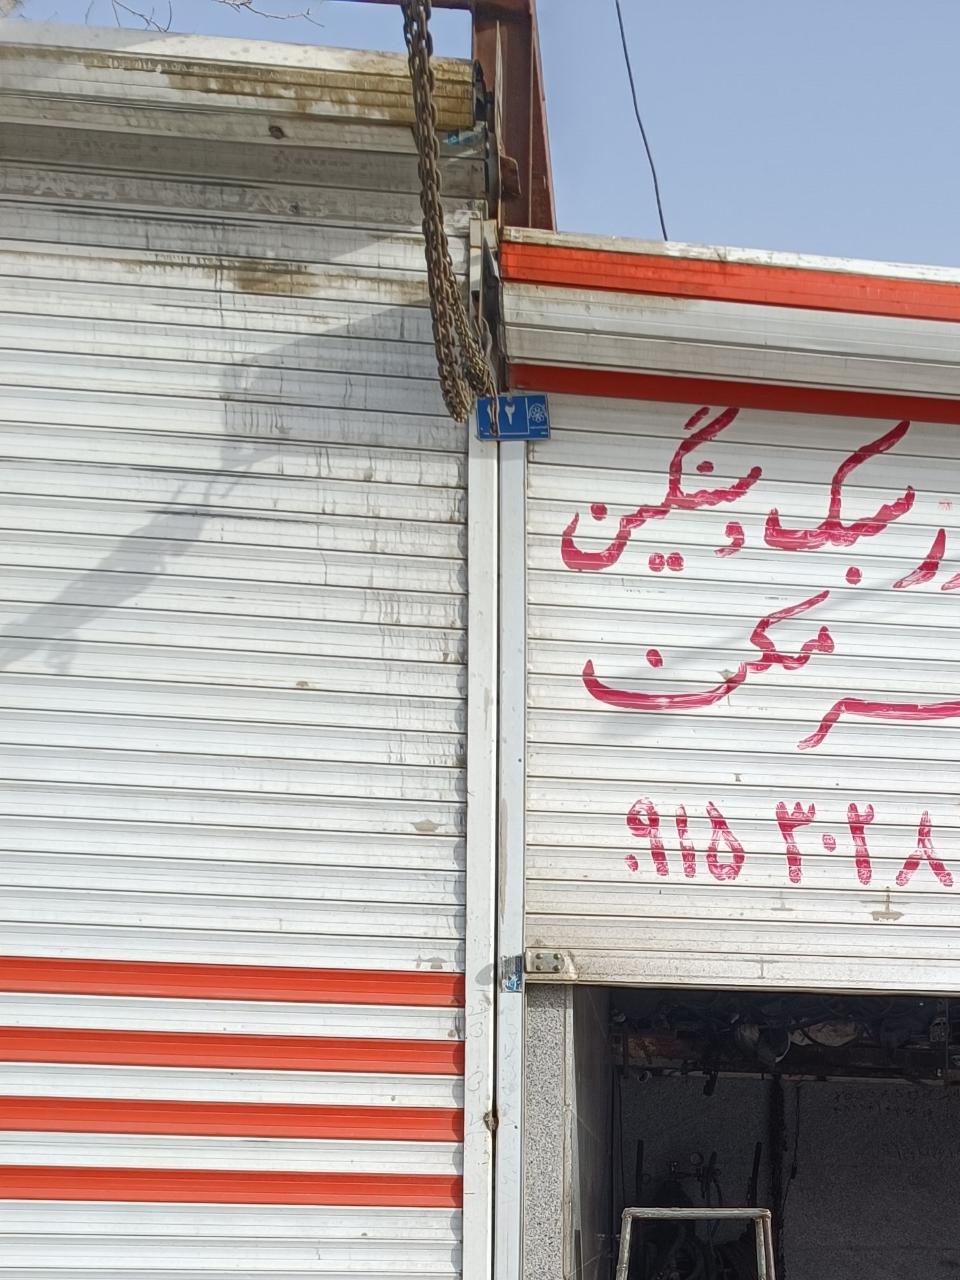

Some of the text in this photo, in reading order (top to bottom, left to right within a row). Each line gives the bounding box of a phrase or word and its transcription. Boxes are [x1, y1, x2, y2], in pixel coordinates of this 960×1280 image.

[560, 406, 762, 573] سنگین
[714, 520, 745, 558] و
[764, 420, 916, 586] سبک
